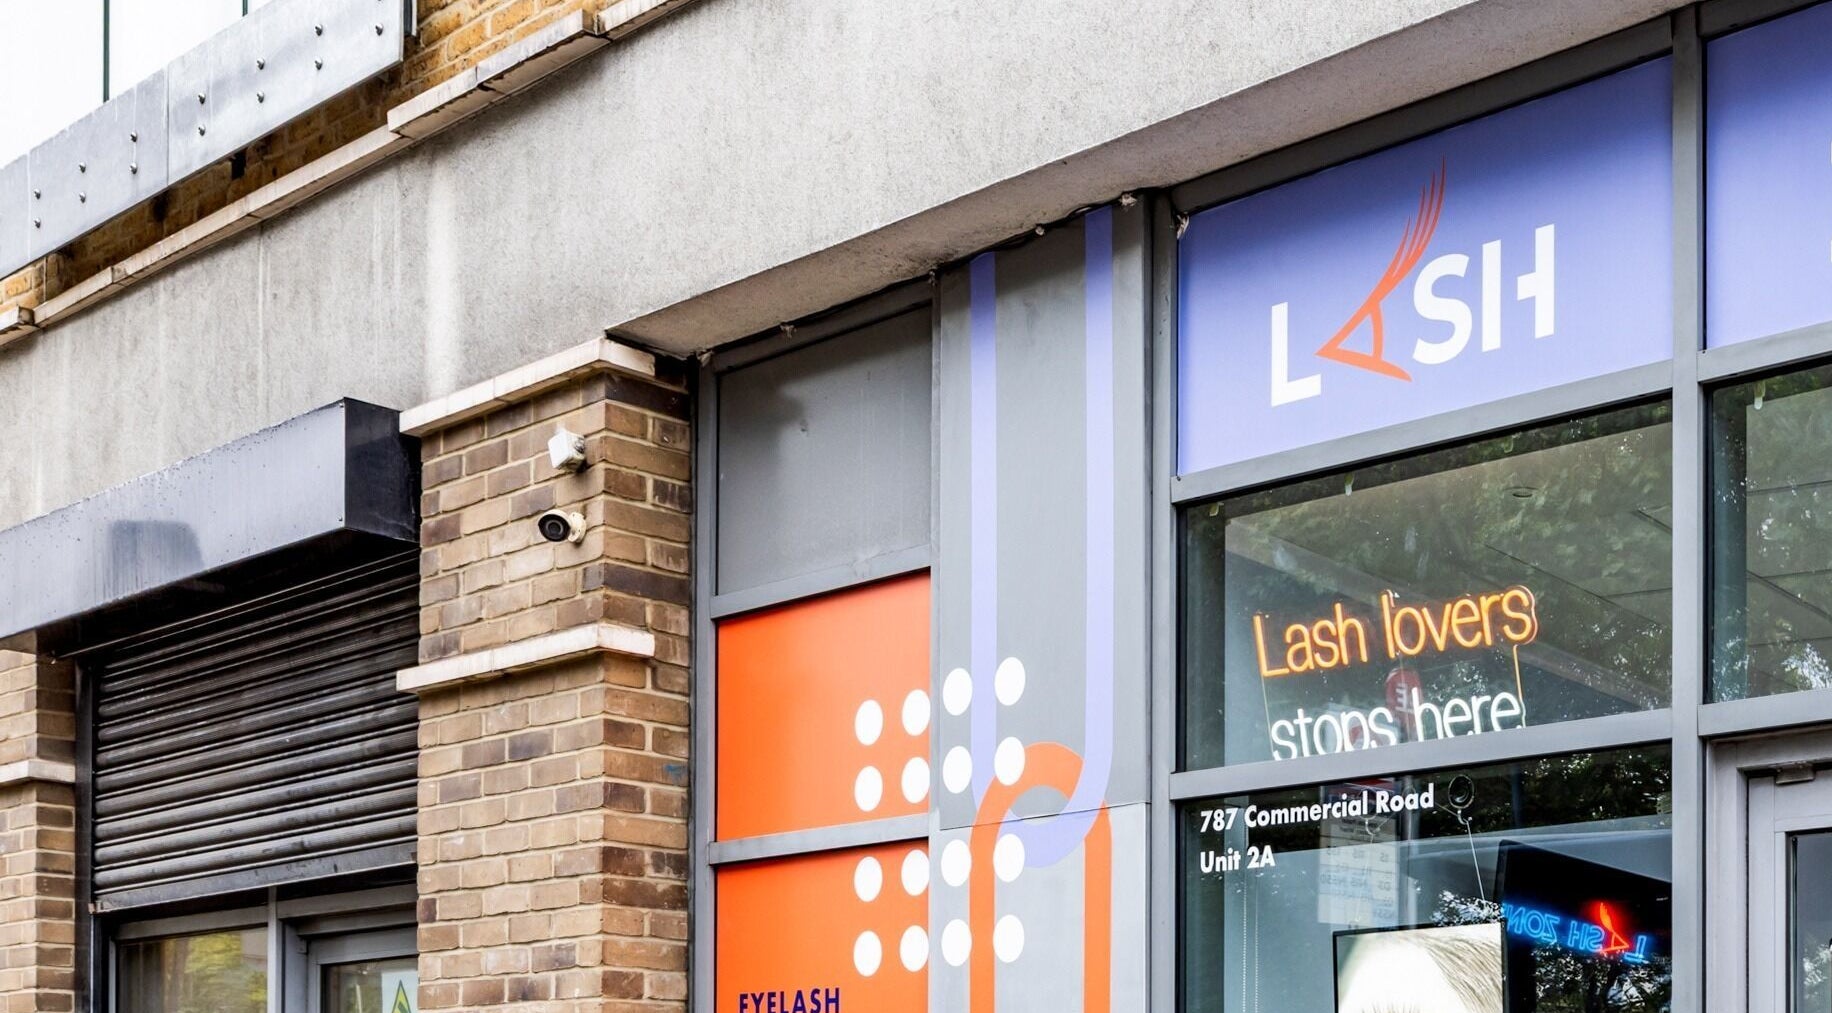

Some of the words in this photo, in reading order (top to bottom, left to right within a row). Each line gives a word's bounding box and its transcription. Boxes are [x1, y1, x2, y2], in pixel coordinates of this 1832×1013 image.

[1271, 153, 1555, 408] LASH
[1253, 603, 1368, 679] Lash
[1380, 585, 1538, 659] lovers
[1270, 706, 1397, 761] stops
[1412, 687, 1523, 741] here
[1200, 807, 1239, 833] 787
[1244, 790, 1369, 828] Commercial
[1376, 783, 1435, 814] Road
[1200, 848, 1241, 873] Unit
[1247, 845, 1276, 869] 2A
